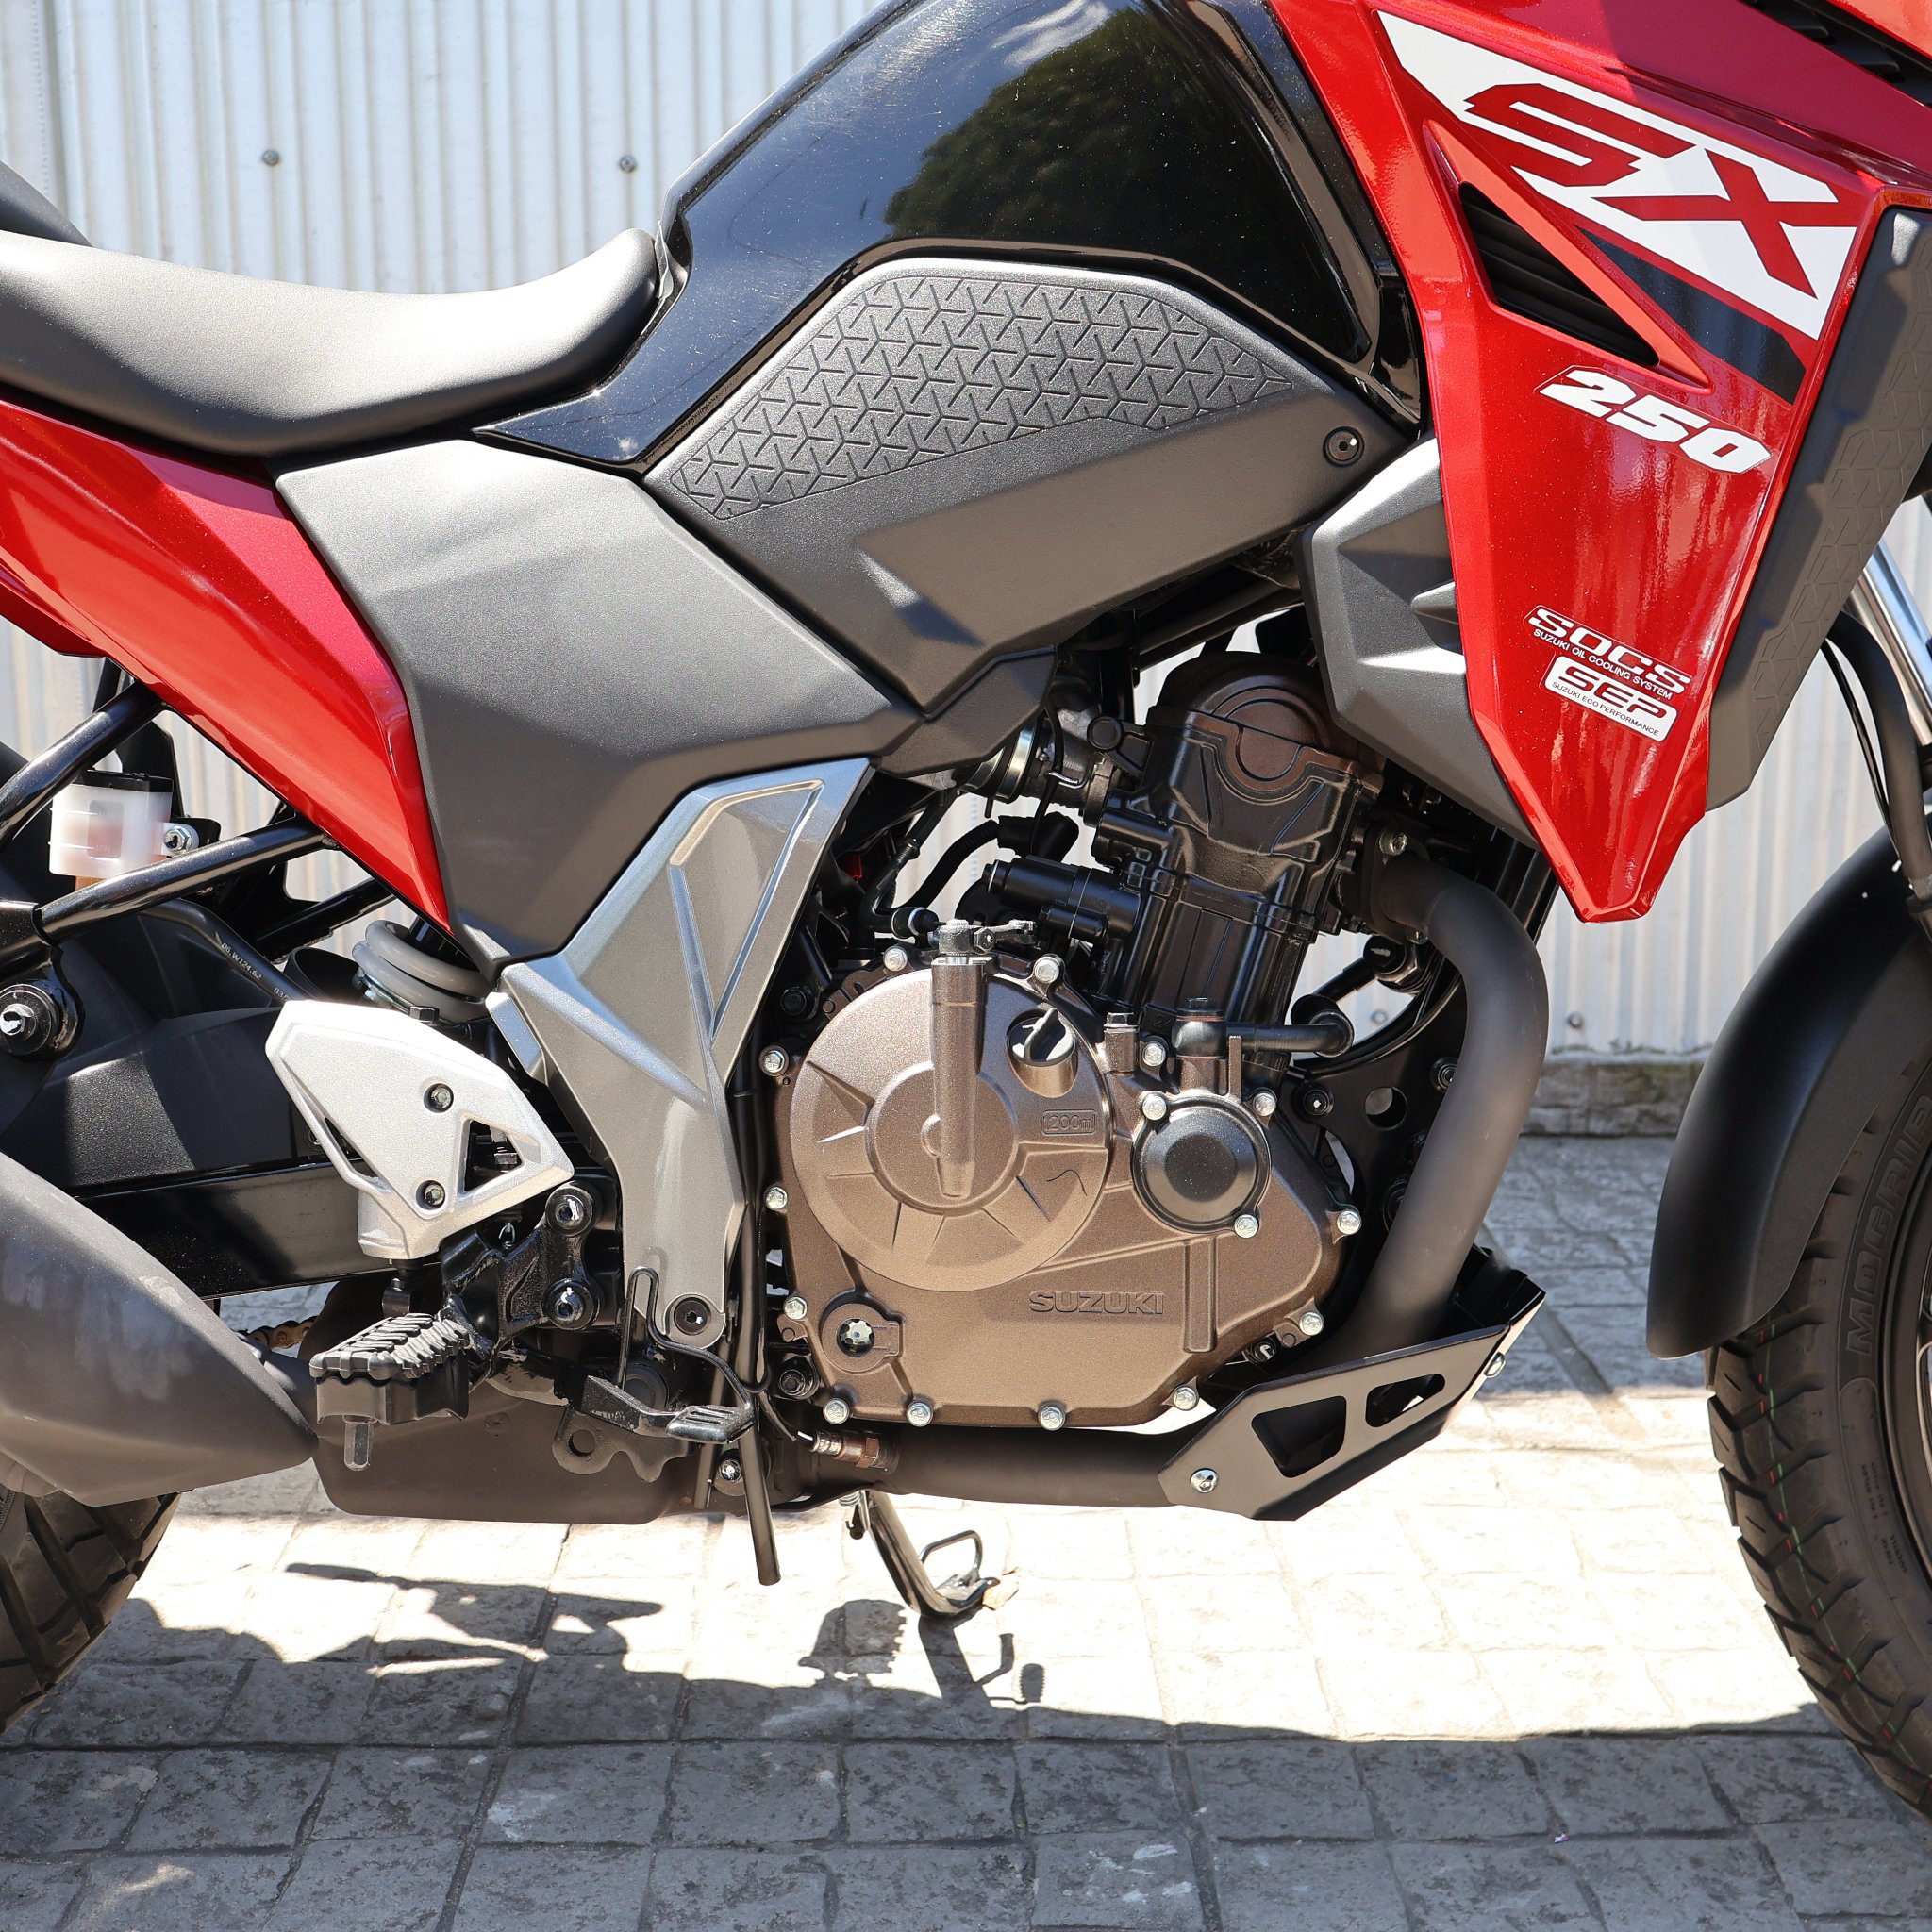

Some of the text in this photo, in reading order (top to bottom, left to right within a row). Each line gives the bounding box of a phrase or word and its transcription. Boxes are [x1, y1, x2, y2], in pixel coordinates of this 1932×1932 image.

[1463, 83, 1857, 300] SX
[1539, 369, 1772, 474] 250
[1528, 608, 1692, 694] SOCS
[1533, 628, 1673, 700] SUZUKI OIL COOLING SYSTEM
[1552, 681, 1660, 737] SUZUKI ECO PERFORMANCE
[1558, 666, 1668, 719] SEP
[1845, 1094, 1932, 1356] MOGRIP
[1029, 1290, 1164, 1315] SUZUKI
